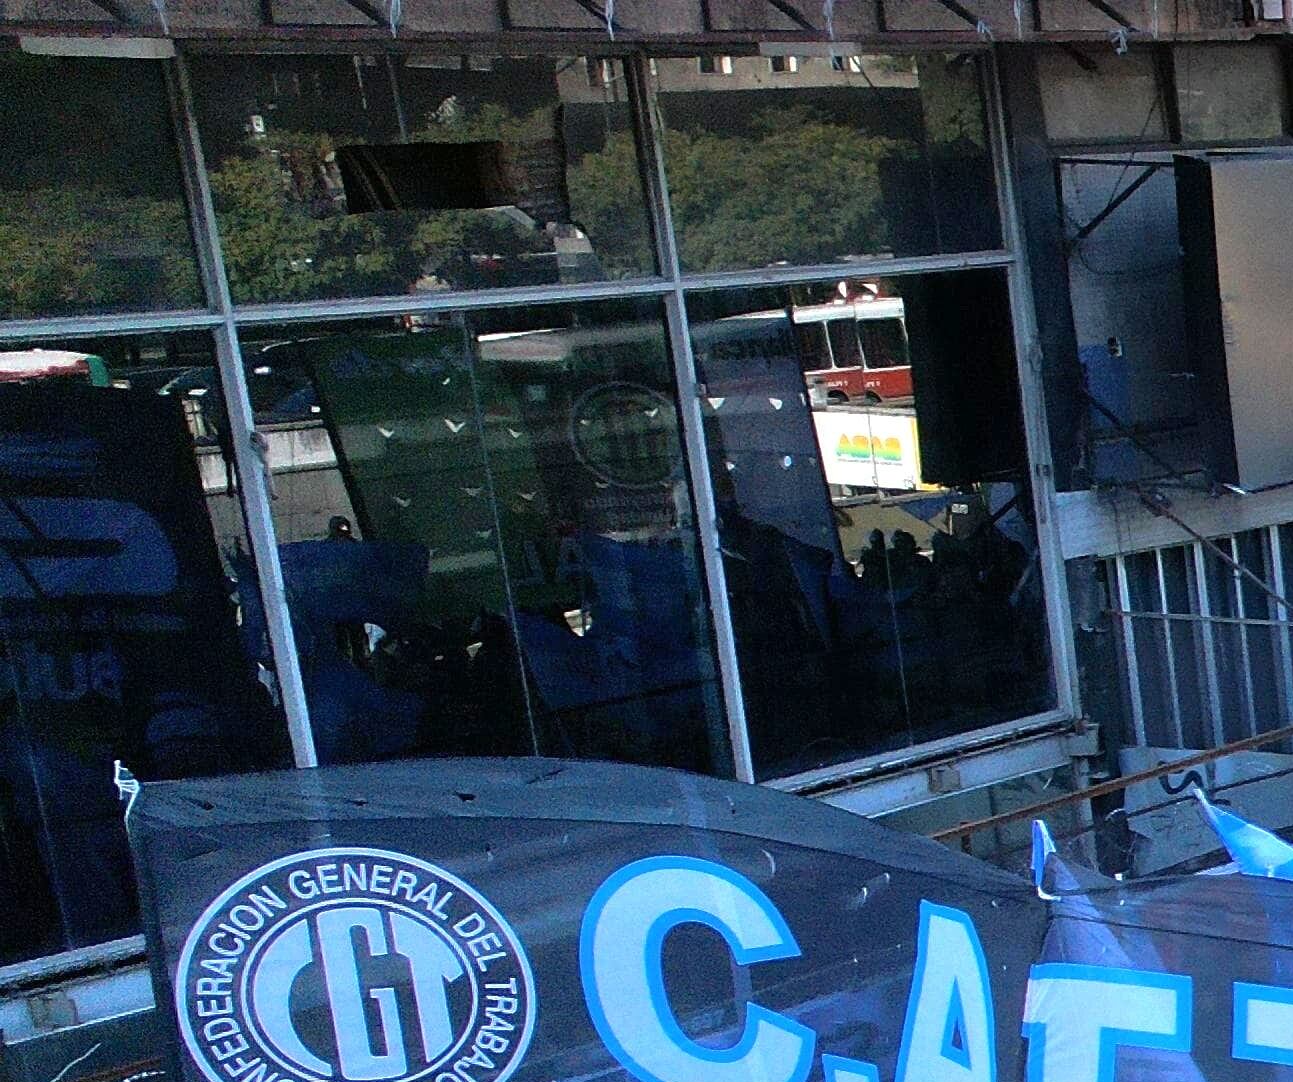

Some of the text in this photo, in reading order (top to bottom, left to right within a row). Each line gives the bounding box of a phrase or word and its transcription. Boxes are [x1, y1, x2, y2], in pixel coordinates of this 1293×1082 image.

[289, 863, 453, 920] GENERAL
[453, 913, 507, 972] DEL
[253, 906, 464, 1081] CGT
